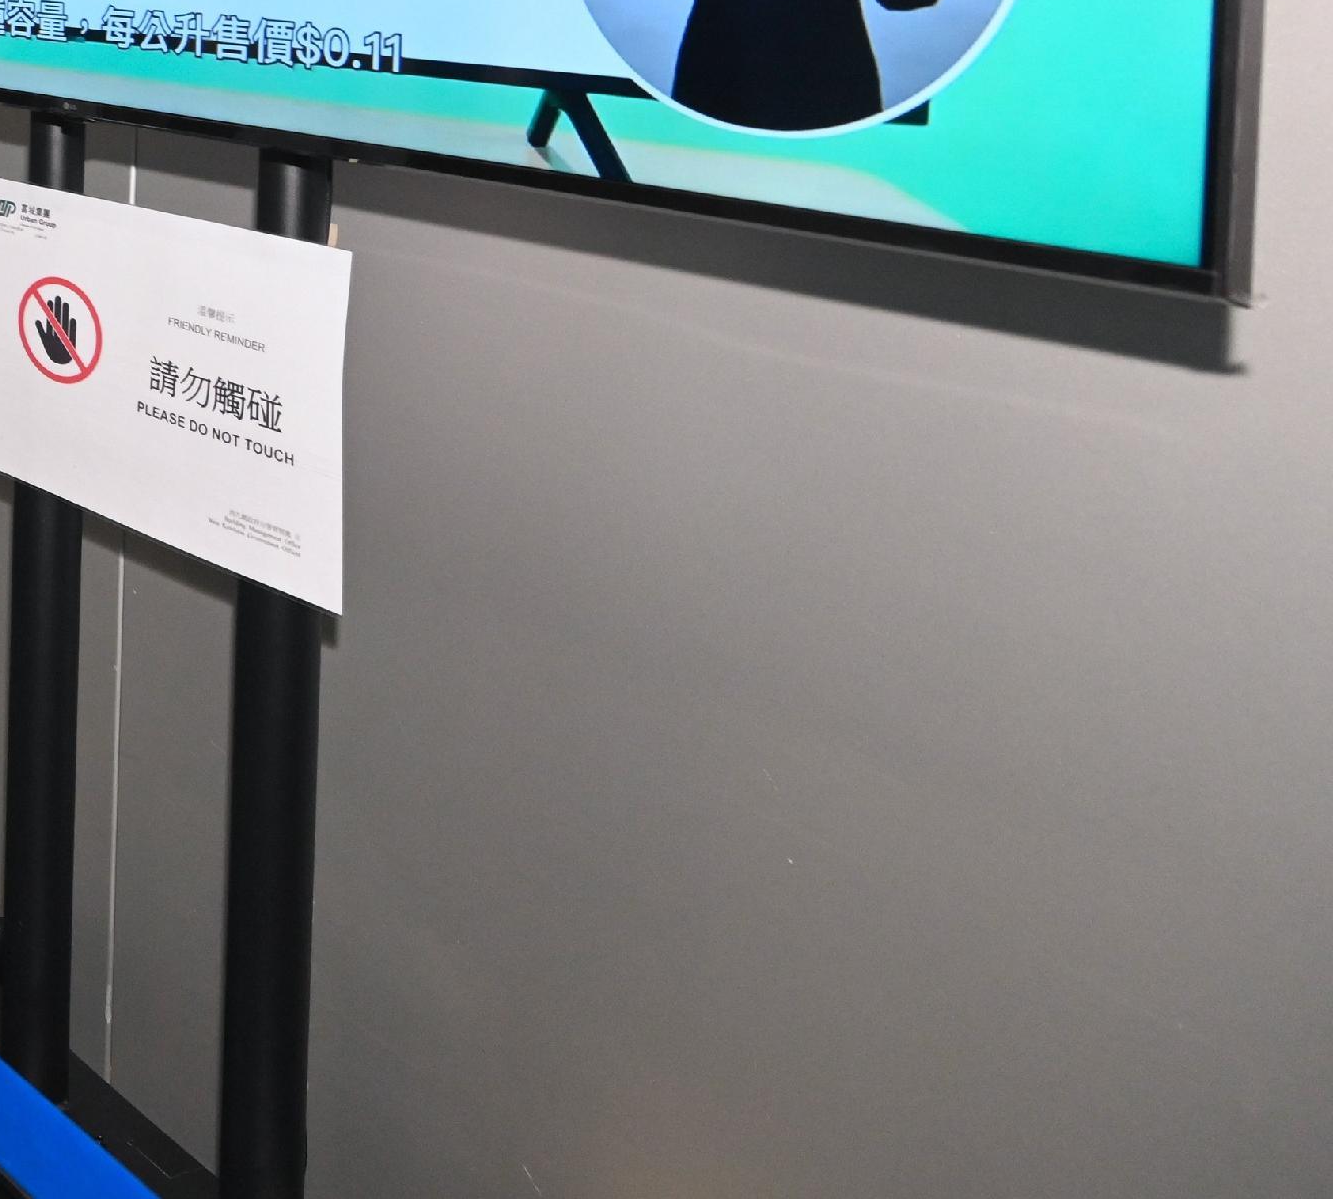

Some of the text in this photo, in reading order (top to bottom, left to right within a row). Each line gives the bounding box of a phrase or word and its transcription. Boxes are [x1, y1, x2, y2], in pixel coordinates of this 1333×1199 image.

[20, 215, 57, 229] Urban Group
[167, 316, 266, 353] FRIENDLY REMINDER
[149, 355, 284, 434] 請勿觸碰
[136, 400, 295, 467] PLEASE DO NOT TOUCH
